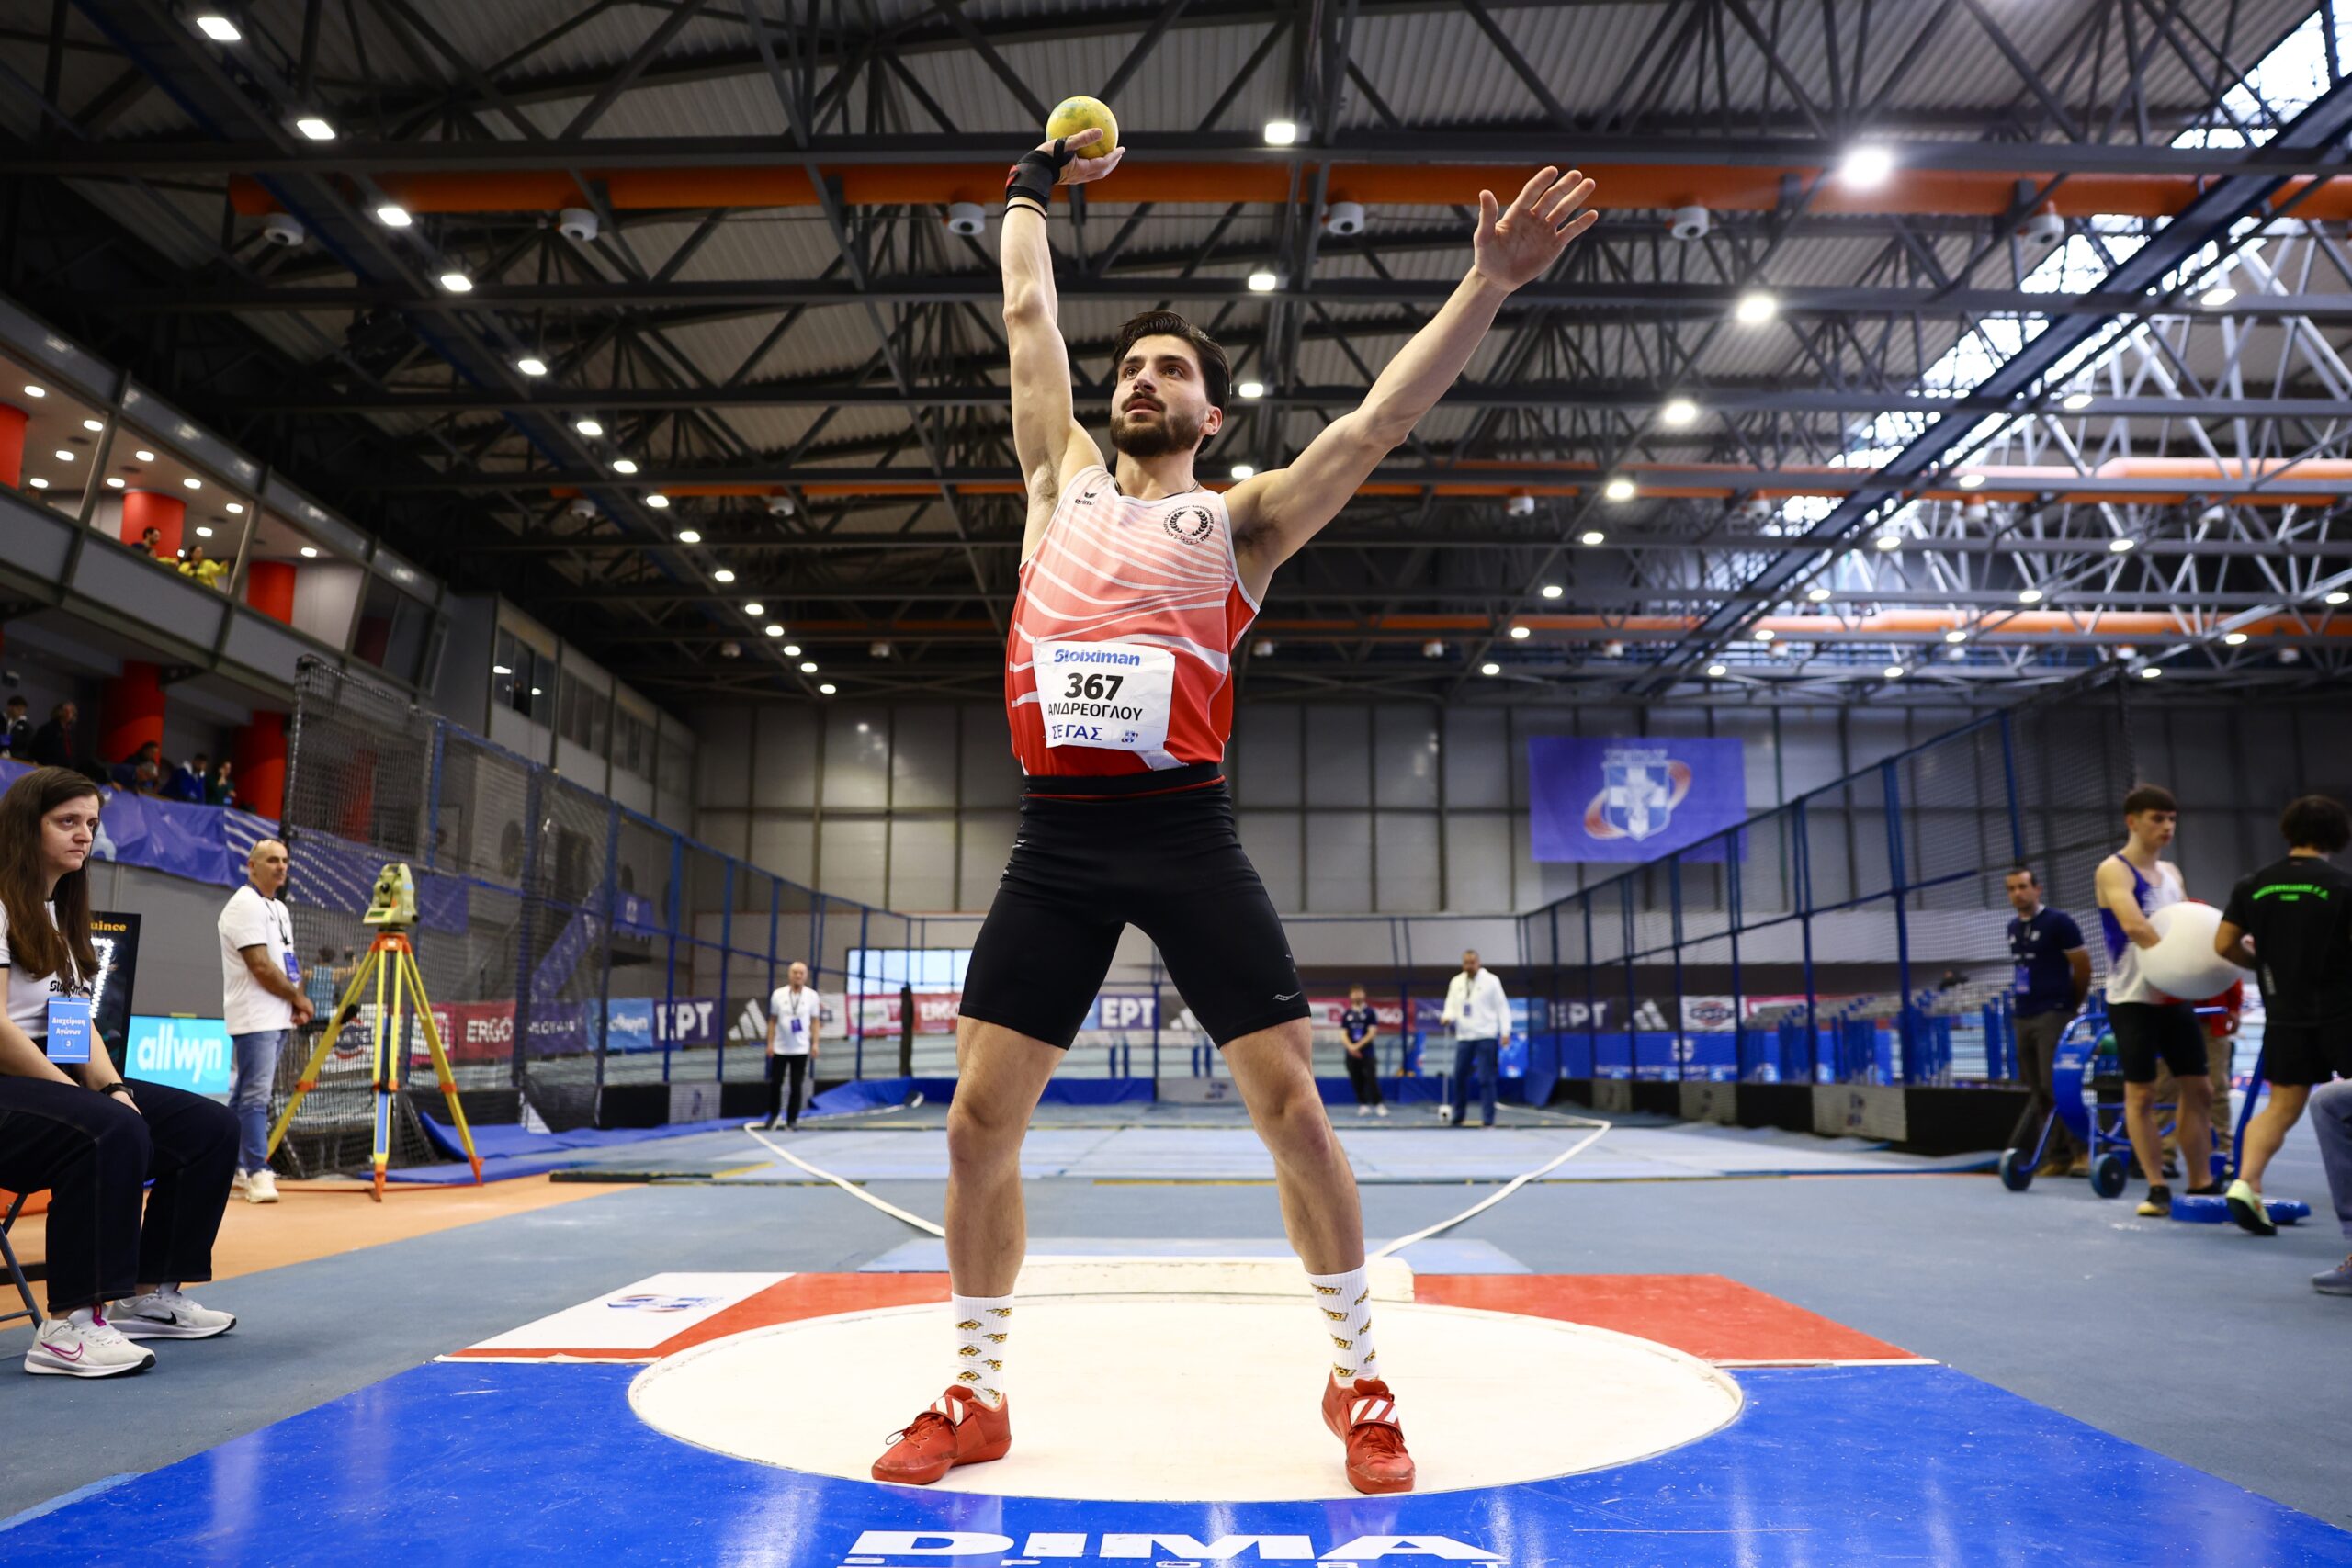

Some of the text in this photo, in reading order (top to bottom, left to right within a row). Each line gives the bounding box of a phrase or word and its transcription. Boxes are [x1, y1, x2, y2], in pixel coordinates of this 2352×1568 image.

[1054, 649, 1140, 666] Stoiximan
[1064, 672, 1124, 701] 367
[1048, 703, 1143, 721] ΑΝΔΡΕΟΓΛΟΥ
[1052, 724, 1102, 741] ΣΕΓΑΣ
[466, 1017, 514, 1043] ERGO
[137, 1023, 223, 1083] allwyn
[847, 1530, 1510, 1561] DIMA
